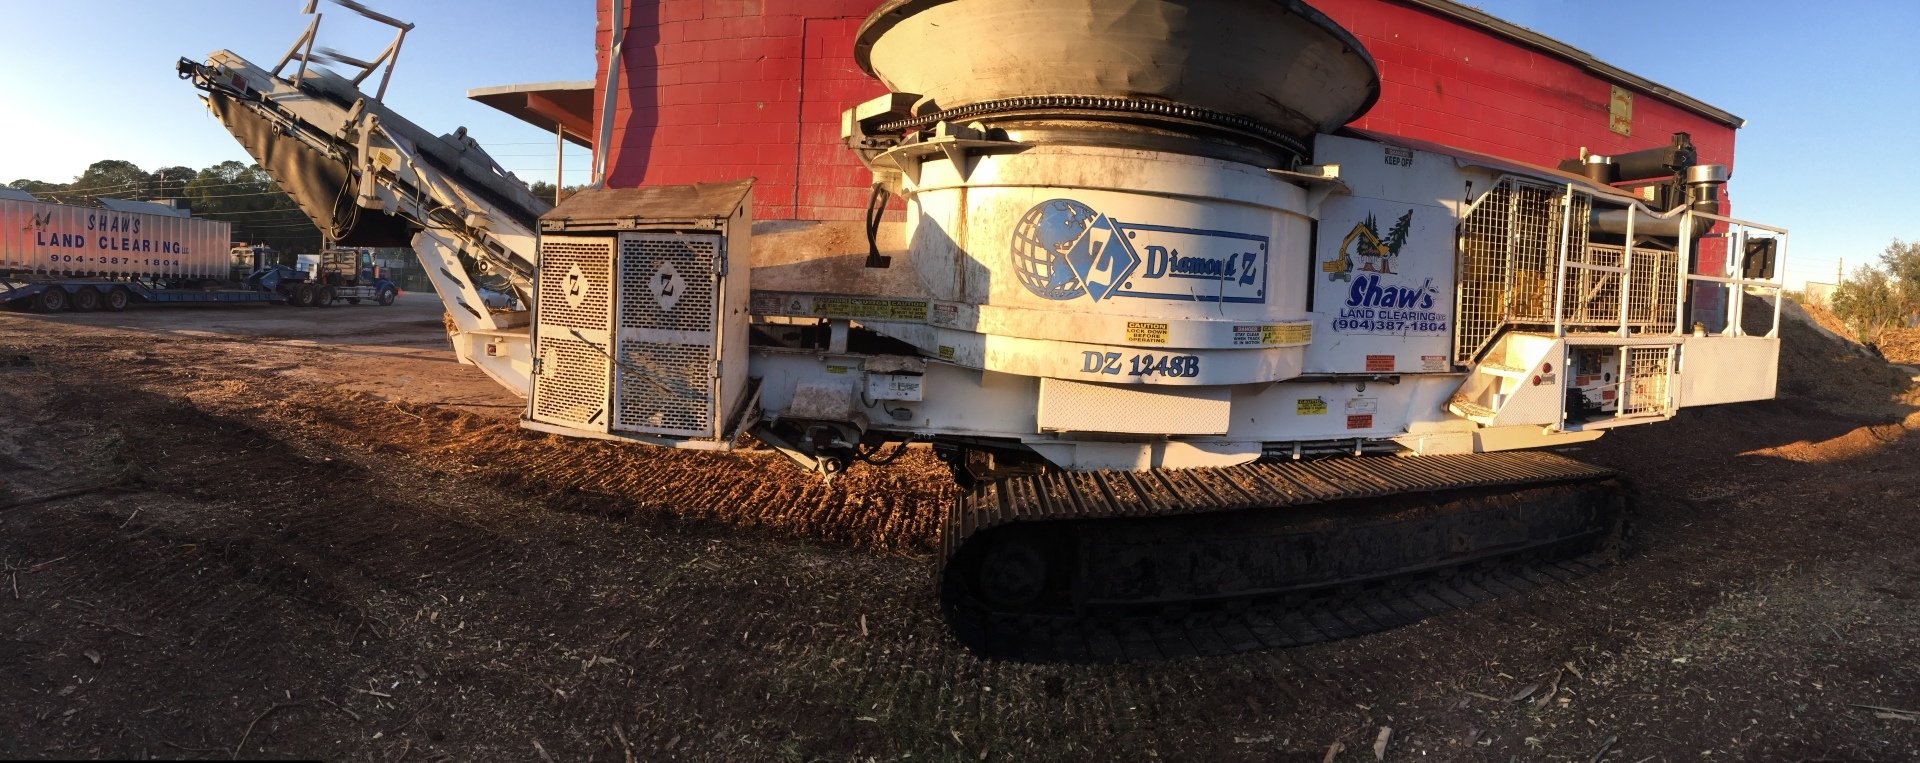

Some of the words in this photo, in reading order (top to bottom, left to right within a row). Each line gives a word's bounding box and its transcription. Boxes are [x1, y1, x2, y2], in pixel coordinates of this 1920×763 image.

[1384, 155, 1400, 166] KEEP
[1401, 158, 1413, 168] OFF
[1464, 180, 1474, 206] Z
[87, 214, 141, 234] SHAW'S
[37, 231, 85, 249] LAND
[98, 235, 181, 255] CLEARING
[1086, 226, 1114, 287] Z
[1142, 245, 1239, 280] Diamond
[1238, 252, 1257, 288] Z
[569, 274, 580, 297] Z
[660, 273, 674, 298] Z
[1345, 274, 1436, 310] Shaw's
[1332, 319, 1447, 333] (904)387-1804
[1340, 308, 1375, 319] LAND
[1379, 310, 1436, 321] CLEARING
[1080, 350, 1123, 375] DZ
[1128, 353, 1200, 378] 1248B
